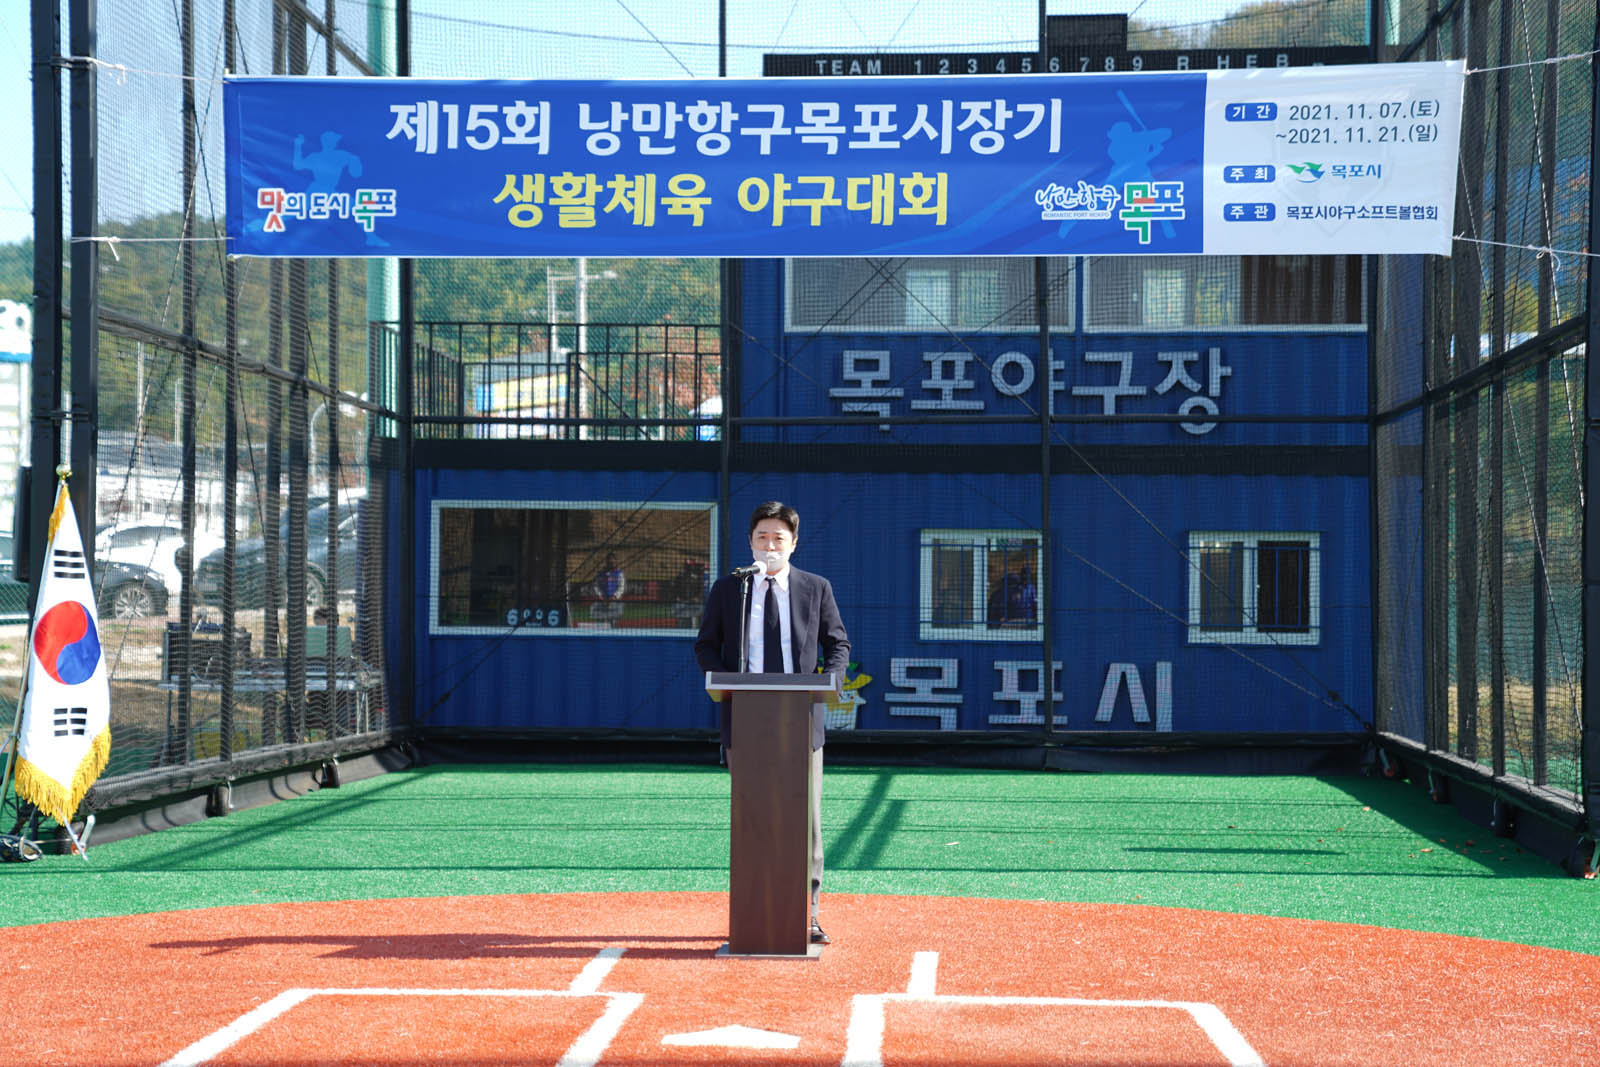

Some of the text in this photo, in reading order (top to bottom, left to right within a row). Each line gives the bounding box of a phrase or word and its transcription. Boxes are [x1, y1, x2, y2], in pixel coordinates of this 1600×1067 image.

[816, 59, 882, 75] TEAM
[914, 60, 923, 74] 1
[939, 59, 950, 74] 2
[967, 58, 978, 73] 3
[996, 58, 1007, 73] 4
[1021, 57, 1032, 73] 5
[1049, 57, 1060, 72] 6
[1080, 57, 1090, 72] 7
[1105, 57, 1115, 72] 8
[1132, 56, 1143, 71] 9
[1177, 56, 1190, 71] R
[1217, 55, 1230, 70] H
[386, 98, 1062, 156] 제15회 낭만항구목포시장기
[1289, 104, 1339, 121] 2021.
[1346, 103, 1373, 120] 11.
[1345, 126, 1371, 144] 11.
[1331, 164, 1382, 180] 목포시
[258, 188, 396, 232] 맛의 도시 목포
[493, 171, 949, 228] 생활체육 야구대회
[1119, 181, 1186, 245] 목포
[1286, 205, 1438, 221] 목포시야구소프트볼협회
[829, 347, 1232, 434] 목포야구장
[884, 658, 1173, 732] 목포시
